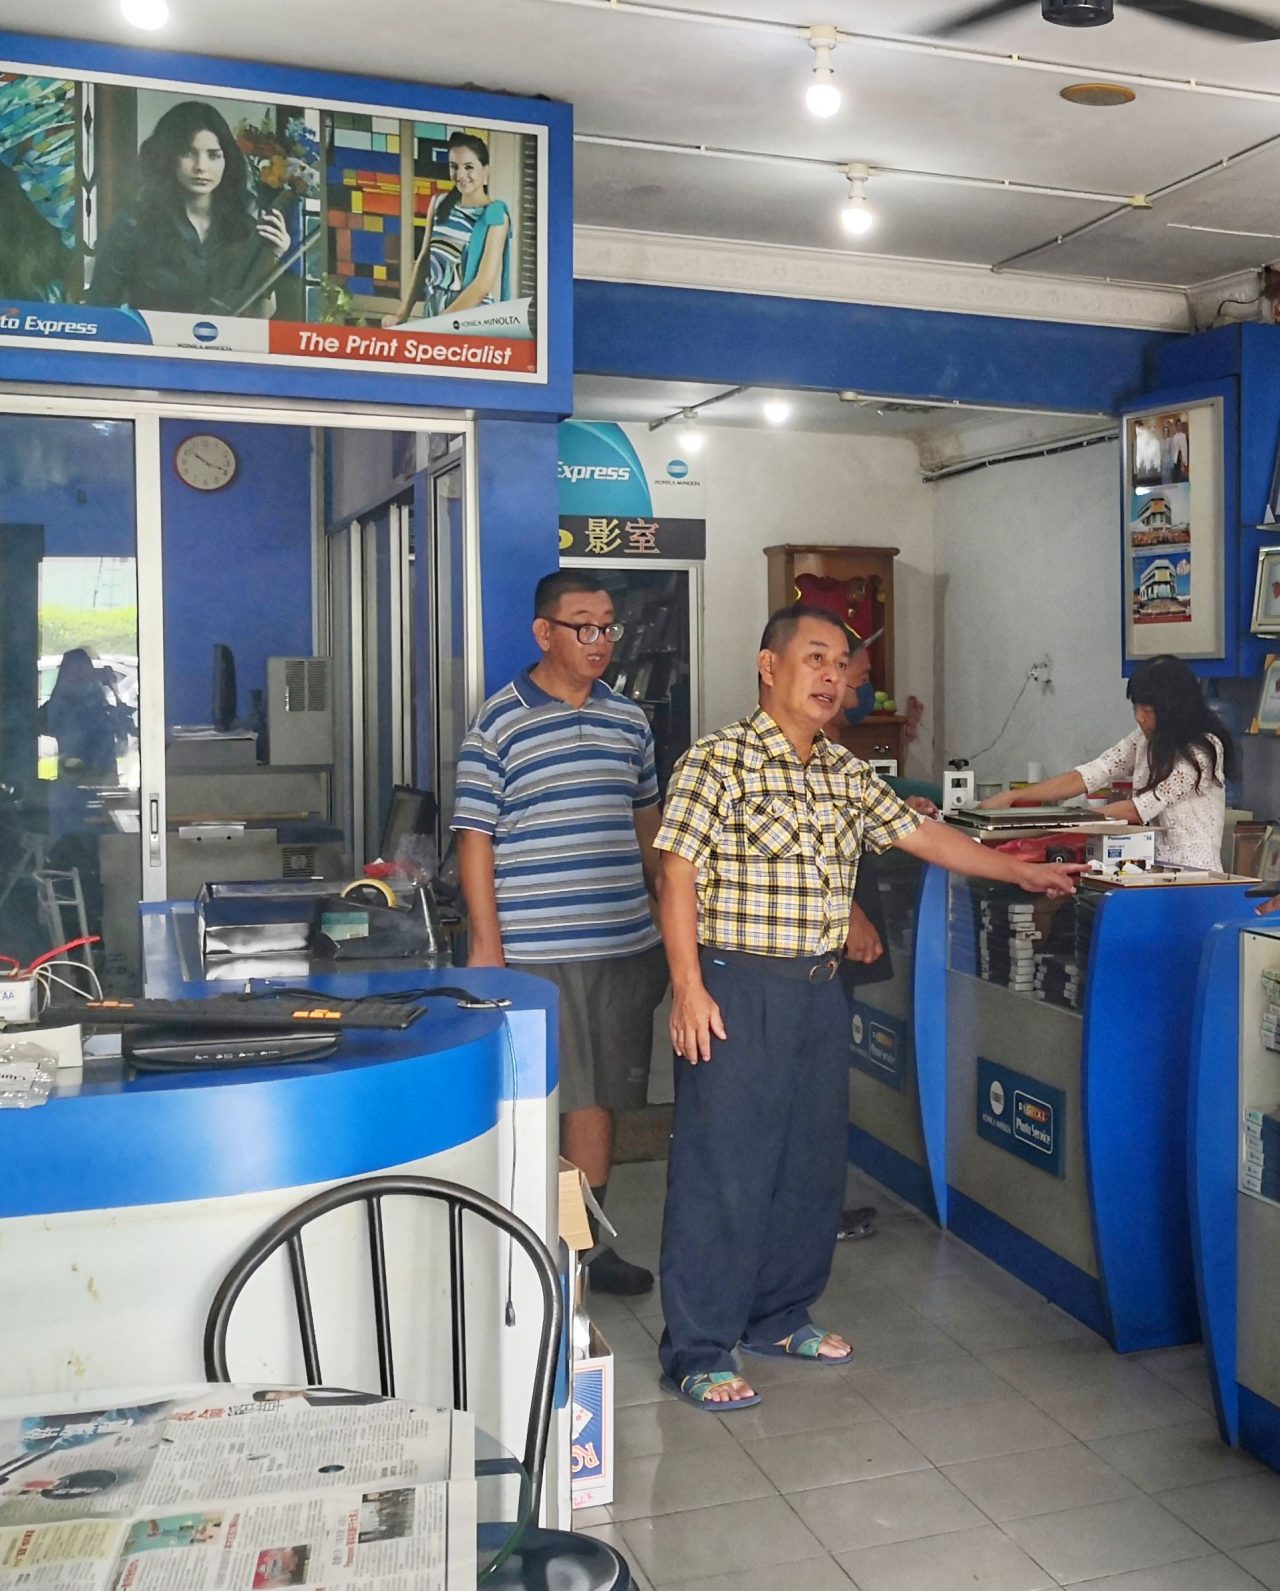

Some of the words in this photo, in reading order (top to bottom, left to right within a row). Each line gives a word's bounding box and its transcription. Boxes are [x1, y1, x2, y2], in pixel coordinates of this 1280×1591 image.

[24, 316, 98, 335] Express
[299, 332, 340, 353] The
[346, 336, 399, 357] Print
[404, 339, 512, 365] Specialist
[584, 518, 661, 554] 影室
